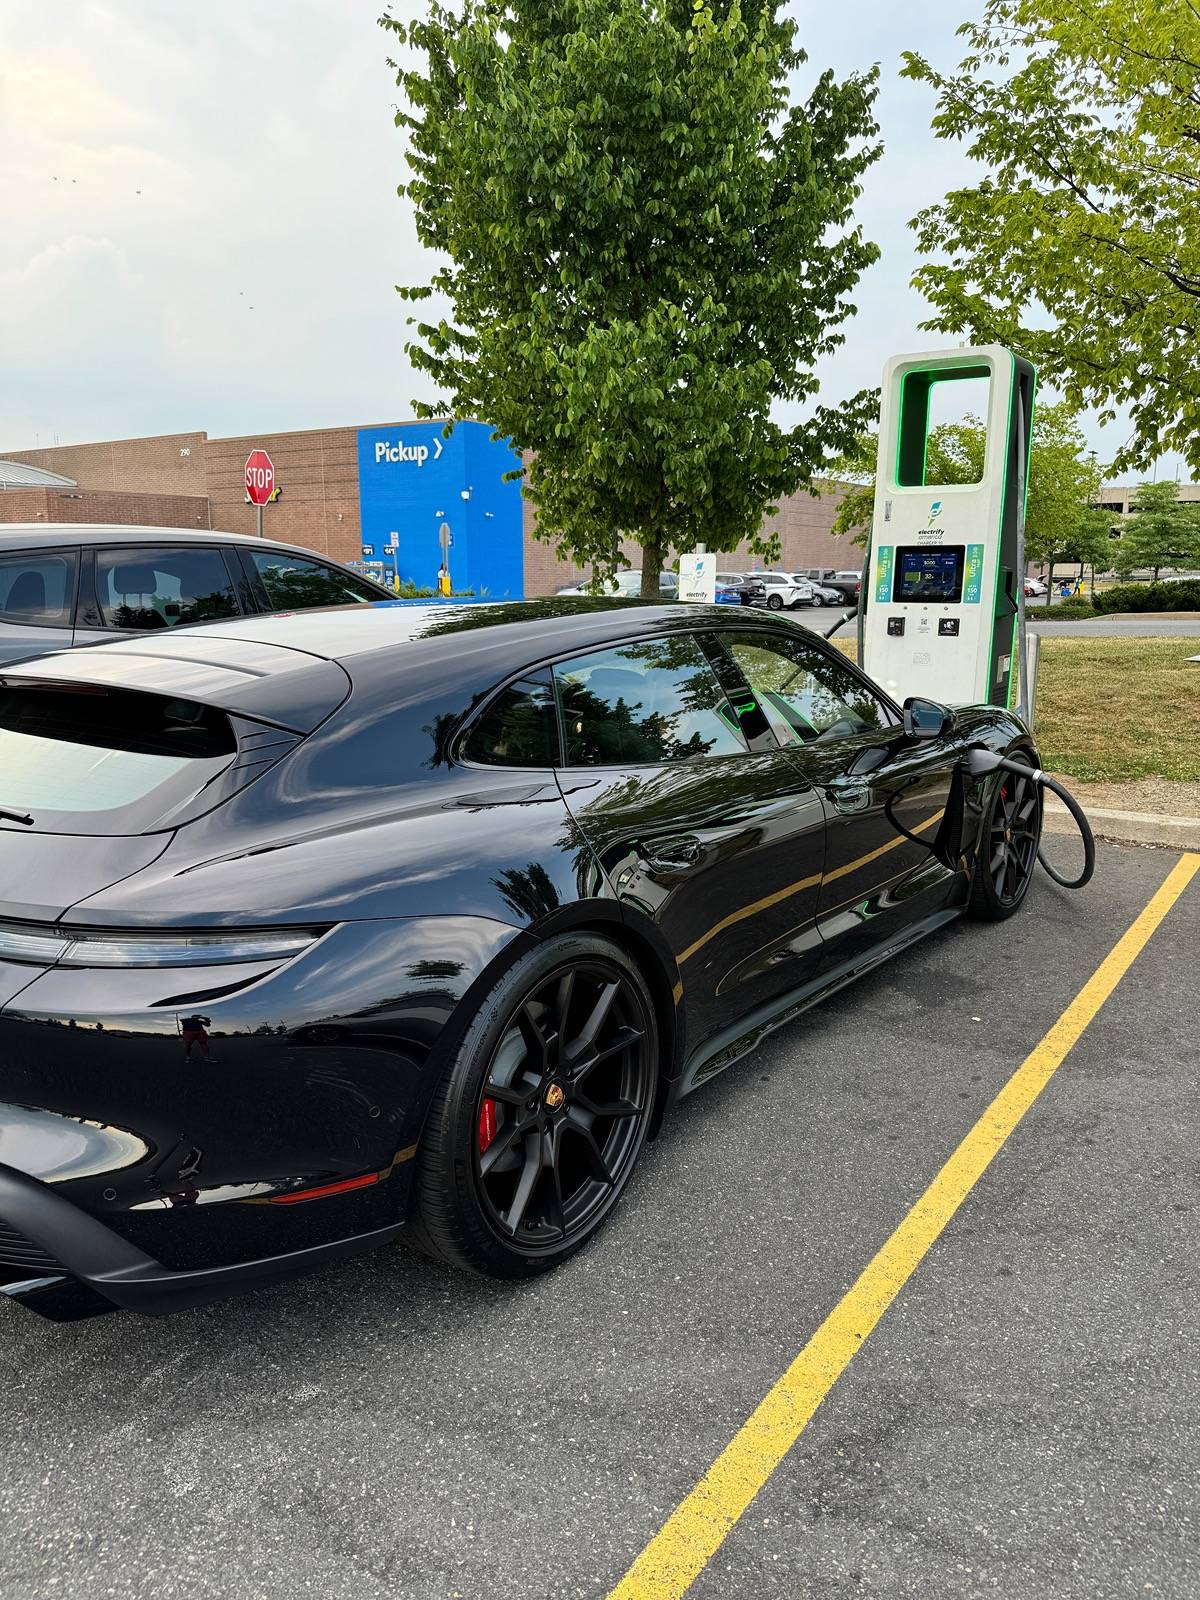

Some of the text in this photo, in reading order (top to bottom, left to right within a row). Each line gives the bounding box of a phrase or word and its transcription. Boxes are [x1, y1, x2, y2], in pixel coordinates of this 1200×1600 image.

[180, 447, 191, 457] 290
[375, 441, 428, 466] Pickup
[246, 467, 273, 489] STOP
[918, 528, 945, 536] electrify
[880, 560, 888, 578] Ultra
[968, 558, 977, 578] Ultra
